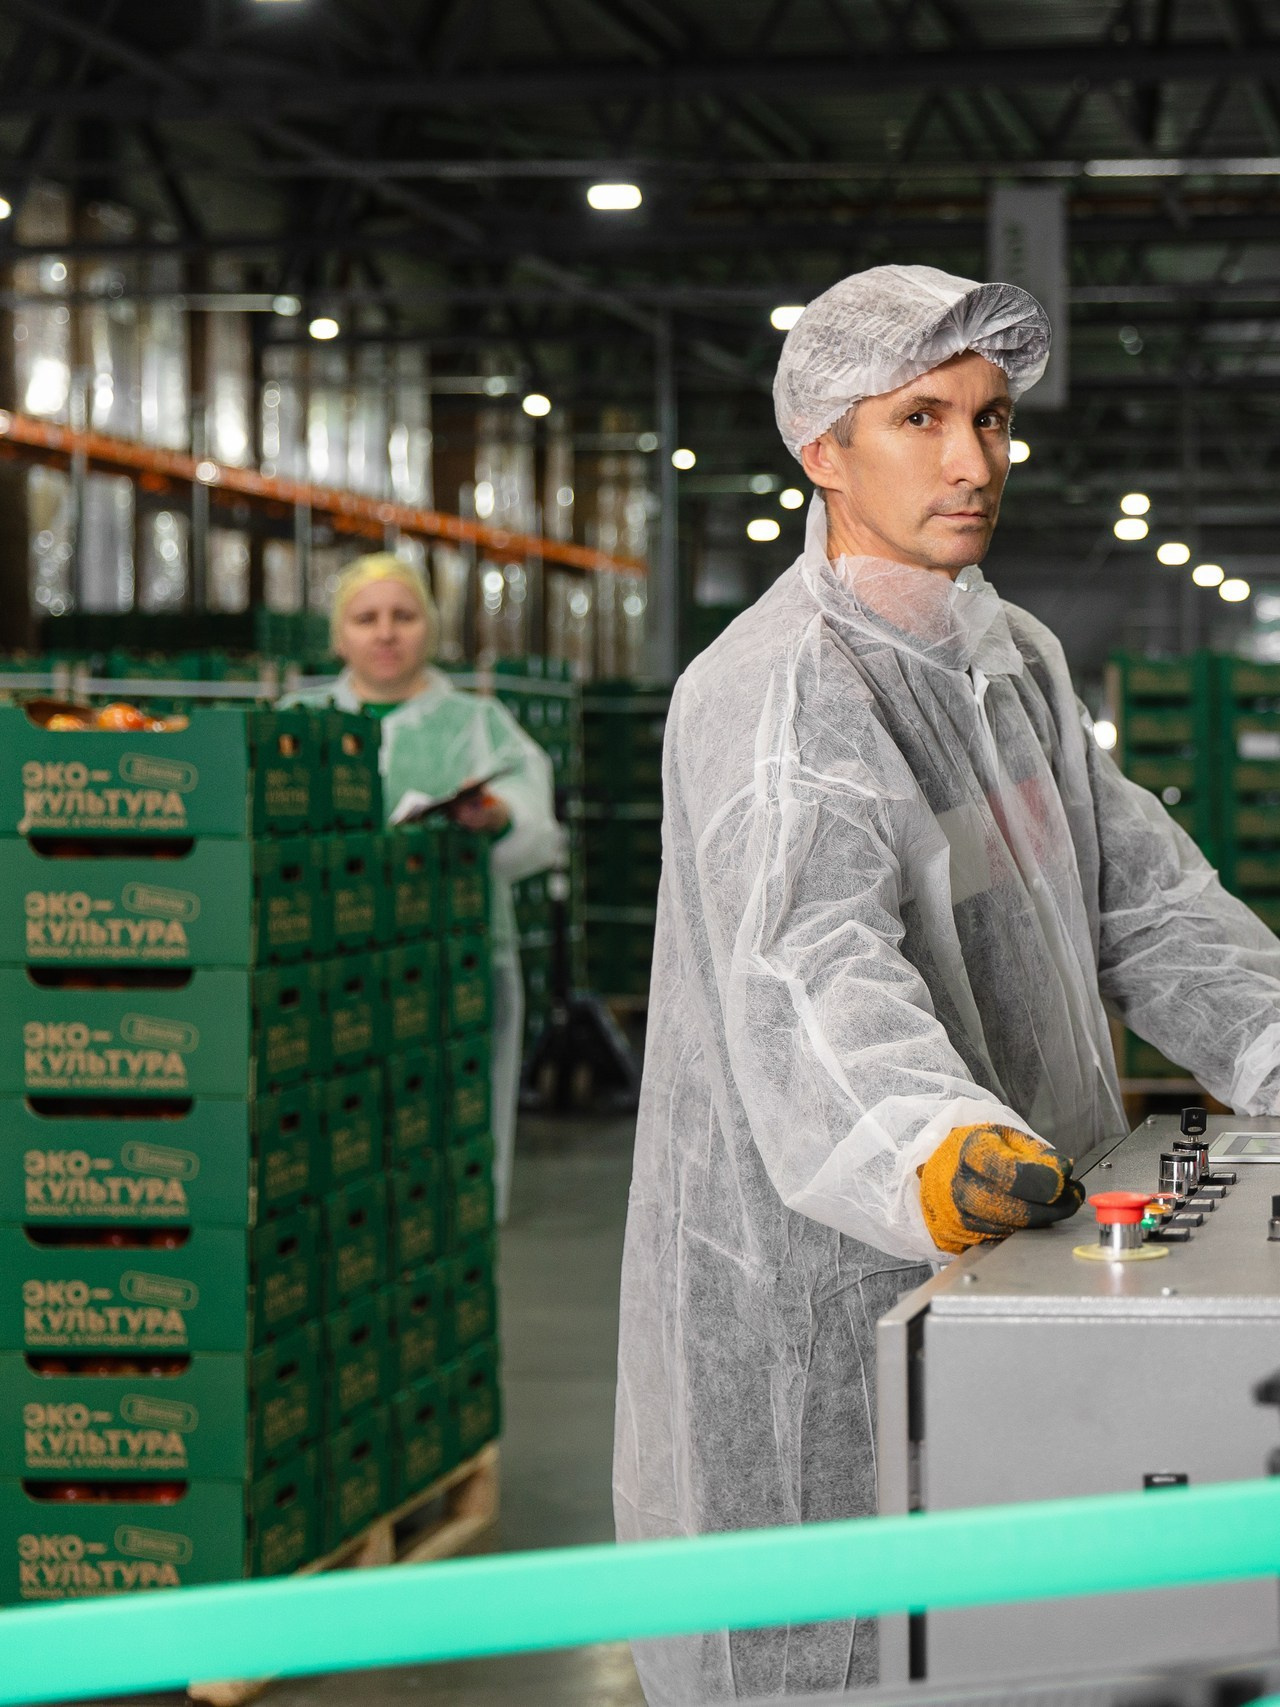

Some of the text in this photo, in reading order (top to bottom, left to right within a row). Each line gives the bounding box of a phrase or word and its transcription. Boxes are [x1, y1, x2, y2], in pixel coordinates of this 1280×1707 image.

[22, 760, 112, 789] ЭКО-
[24, 788, 186, 817] КУЛЬТУРА
[25, 891, 114, 918] ЭКО-
[26, 918, 188, 944] КУЛЬТУРА
[23, 1021, 113, 1048] ЭКО-
[25, 1048, 187, 1075] КУЛЬТУРА
[24, 1150, 113, 1177] ЭКО-
[26, 1177, 187, 1203] КУЛЬТУРА
[22, 1280, 113, 1307] ЭКО-
[24, 1306, 187, 1333] КУЛЬТУРА
[23, 1403, 112, 1429] ЭКО-
[25, 1429, 186, 1455] КУЛЬТУРА
[17, 1534, 107, 1561] ЭКО-
[19, 1560, 181, 1586] КУЛЬТУРА
